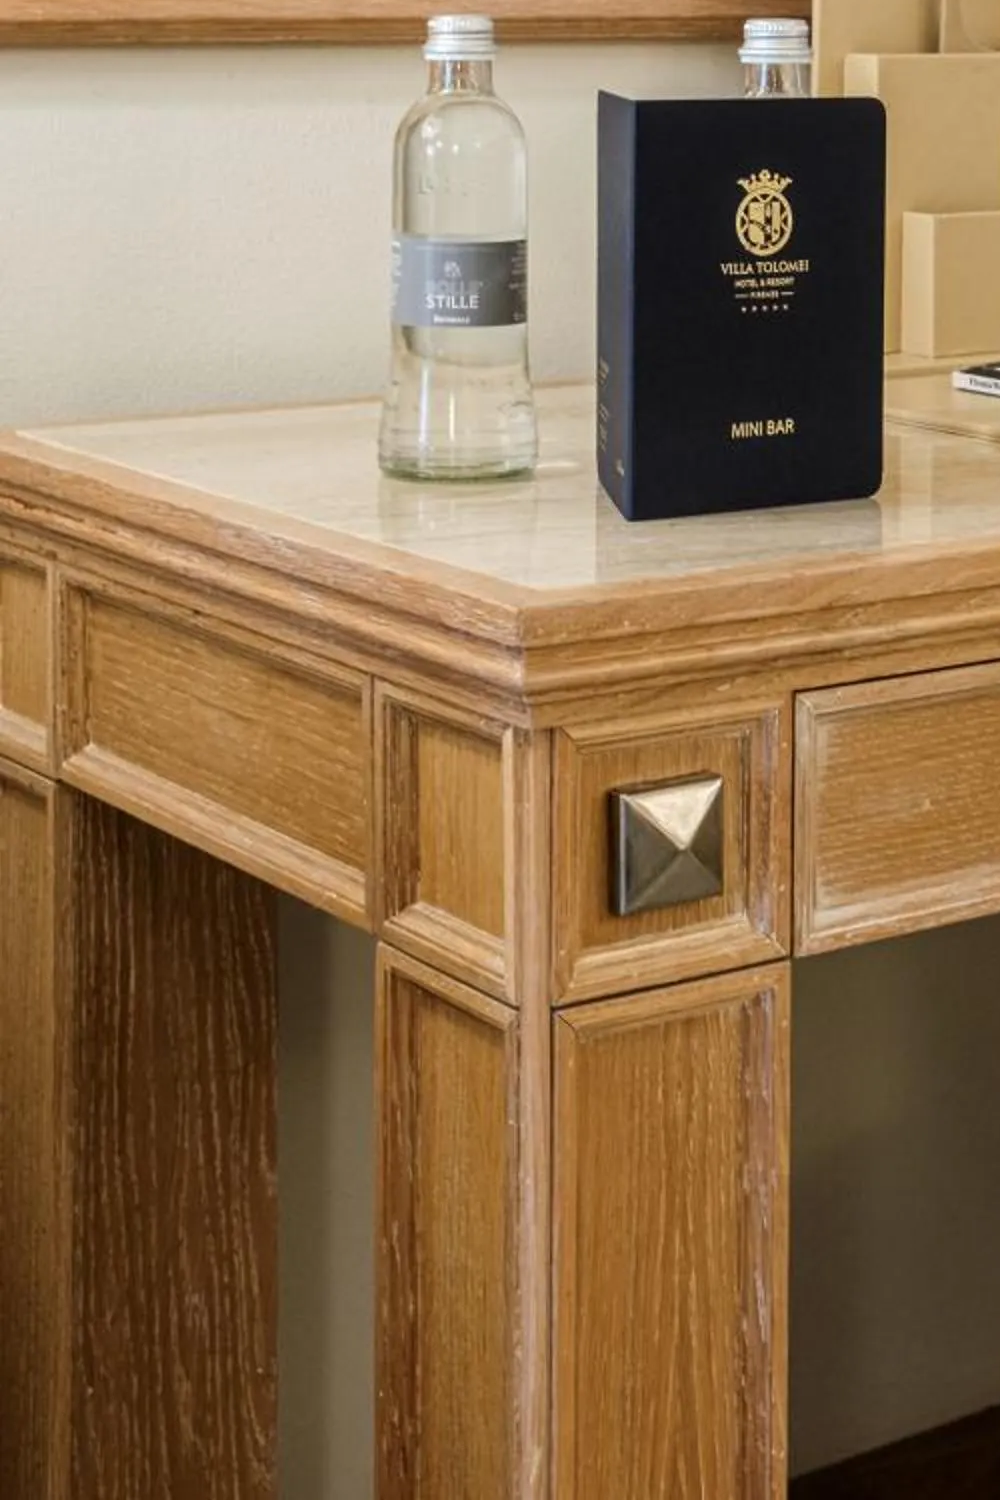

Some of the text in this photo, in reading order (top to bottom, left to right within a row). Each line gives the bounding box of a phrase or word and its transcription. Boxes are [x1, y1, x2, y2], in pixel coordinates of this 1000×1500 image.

[720, 259, 809, 275] VILLA TOLOMEI
[735, 278, 759, 288] HOTEL
[766, 276, 795, 286] RESORT
[425, 294, 480, 309] STILLE
[731, 417, 795, 440] MINI BAR
